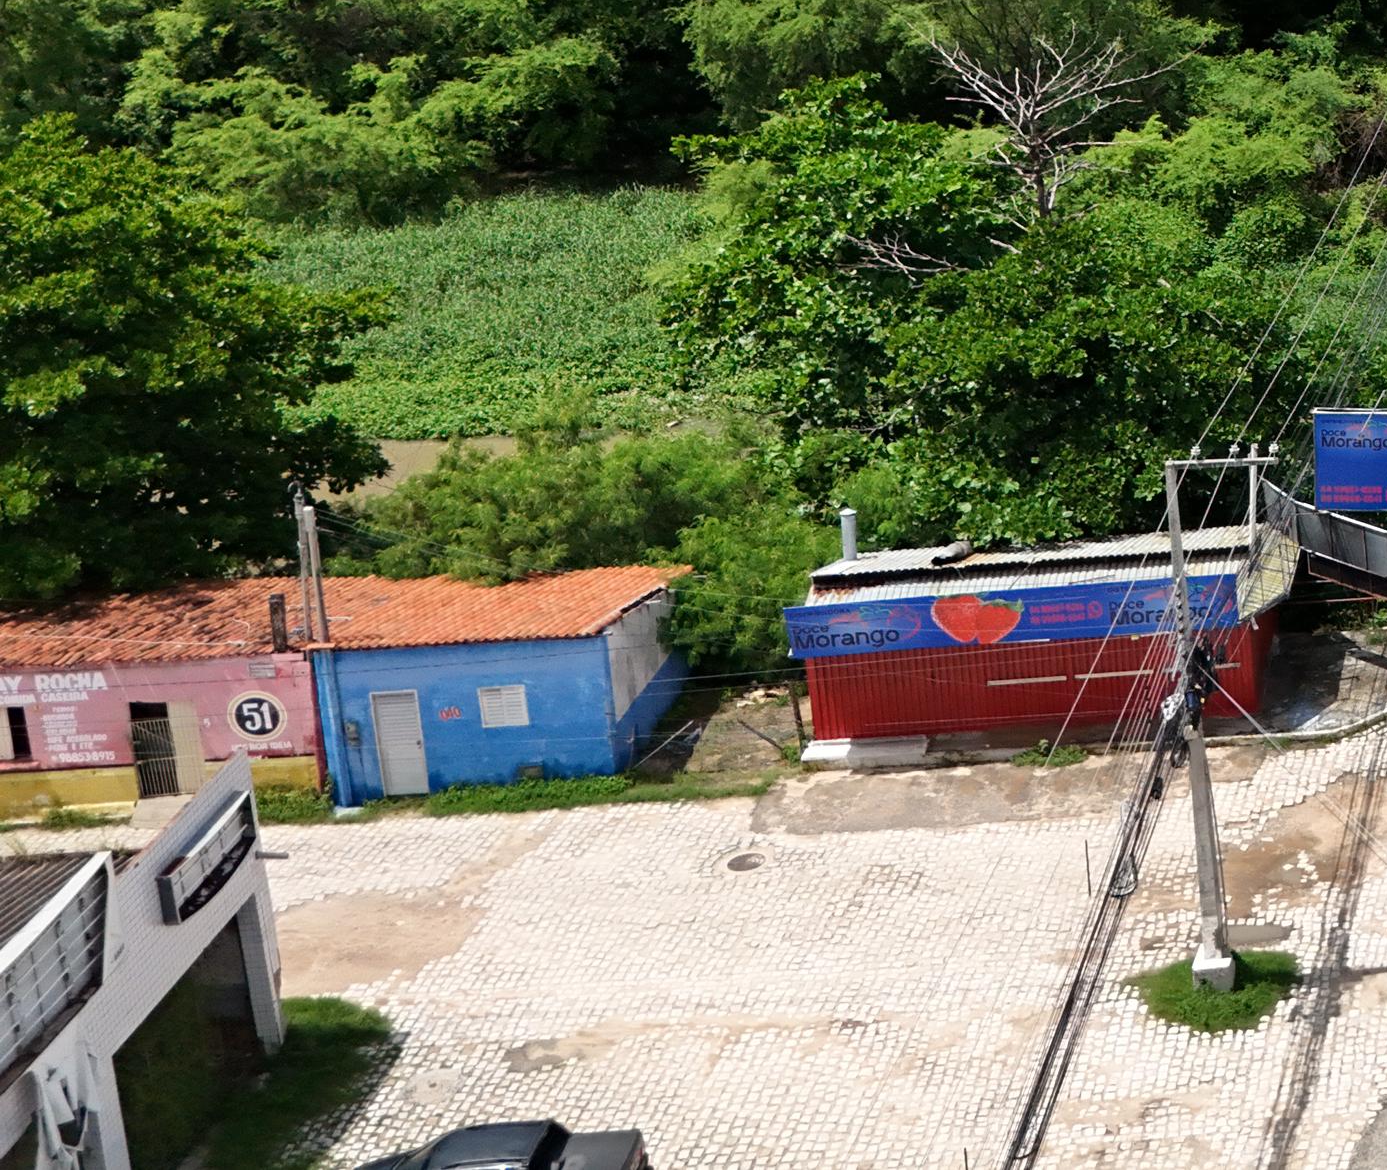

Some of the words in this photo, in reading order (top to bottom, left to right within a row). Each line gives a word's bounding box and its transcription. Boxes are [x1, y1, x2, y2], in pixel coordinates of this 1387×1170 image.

[794, 630, 900, 650] Morango
[35, 672, 108, 691] ROCHA
[40, 691, 89, 703] CASEIRA
[242, 702, 273, 731] 51
